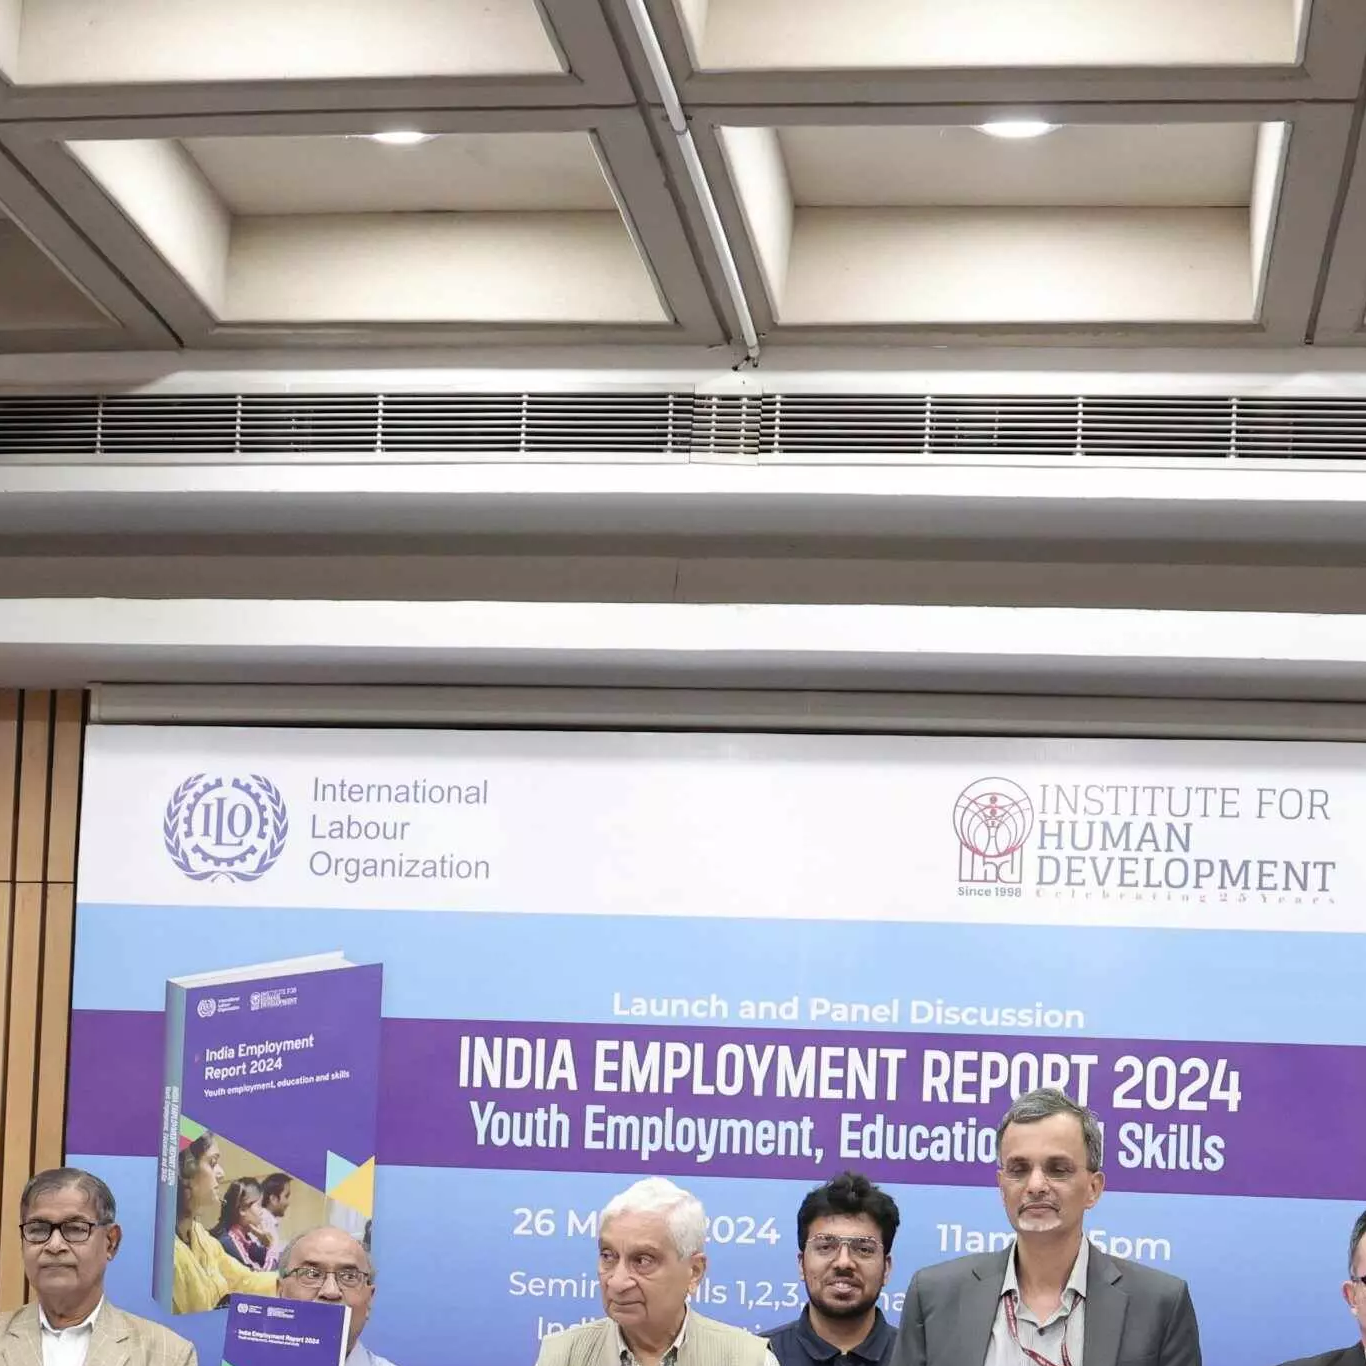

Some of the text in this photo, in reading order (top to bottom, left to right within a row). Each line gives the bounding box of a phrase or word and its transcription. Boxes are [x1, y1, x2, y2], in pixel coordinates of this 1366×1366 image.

[313, 776, 489, 805] International
[1038, 783, 1331, 821] INSTITUTE FOR
[199, 796, 253, 847] ILO
[311, 813, 411, 841] Labour
[1037, 820, 1193, 853] HUMAN
[309, 850, 490, 884] Organization
[1035, 855, 1336, 892] DEVELOPMENT
[957, 885, 1022, 898] Since 1998
[612, 991, 1086, 1029] Launch and Panel Discussion
[205, 1033, 315, 1063] India Employment
[204, 1057, 283, 1081] Report 2024
[458, 1035, 1242, 1113] INDIA EMPLOYMENT REPORT 2024
[203, 1086, 226, 1098] Youth
[469, 1100, 570, 1149] Youth
[583, 1103, 825, 1165] Employment,
[839, 1112, 997, 1164] Educatio
[1117, 1121, 1227, 1173] Skills
[512, 1207, 556, 1238] 26
